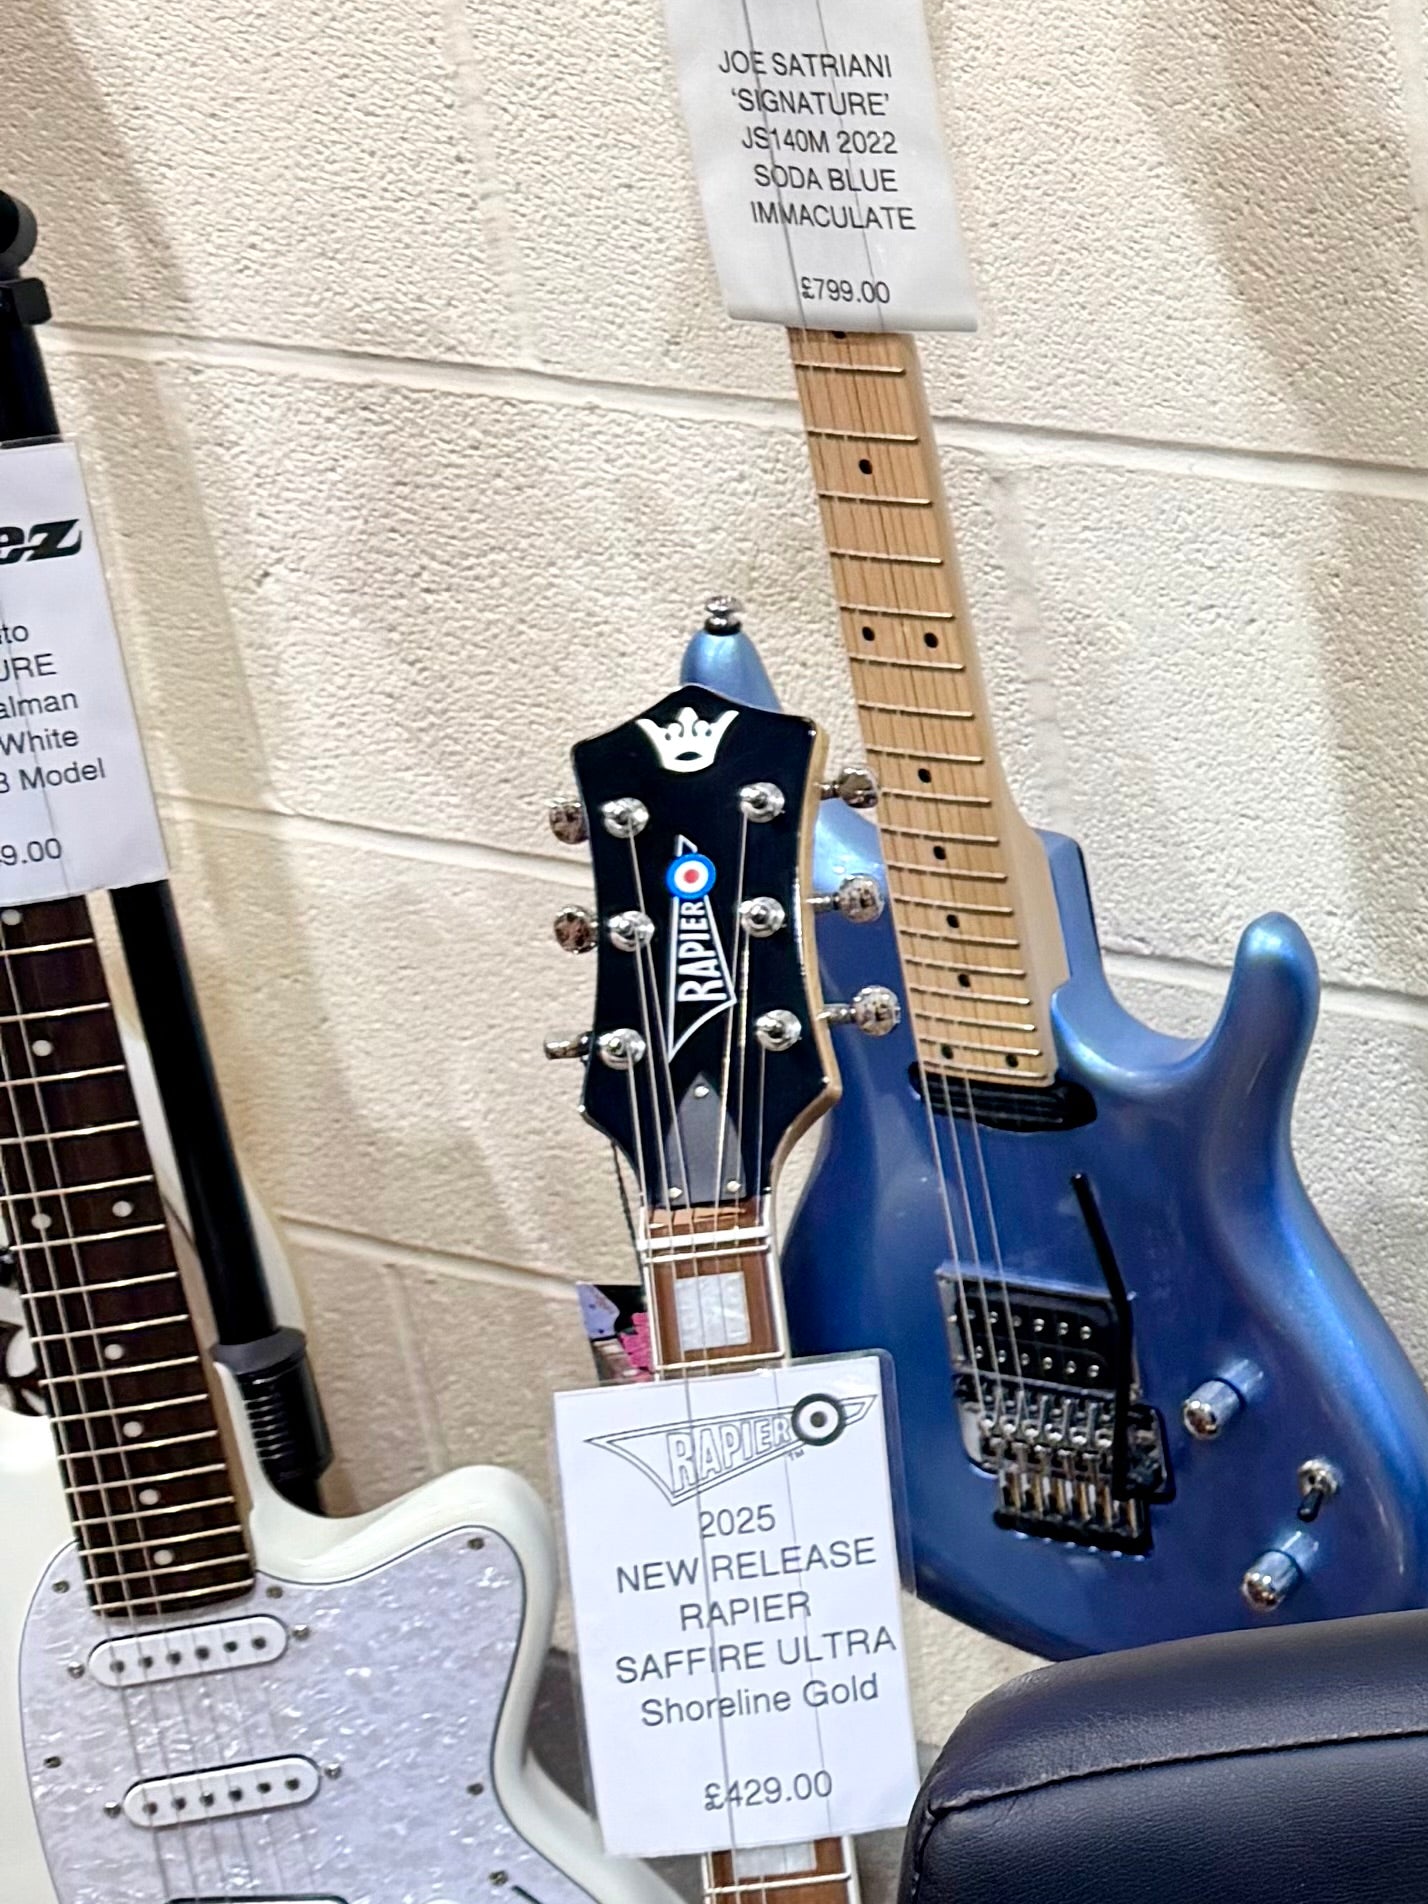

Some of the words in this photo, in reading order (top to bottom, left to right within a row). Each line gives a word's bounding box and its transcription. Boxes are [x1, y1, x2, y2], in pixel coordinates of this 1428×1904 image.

[718, 50, 765, 76] JOE
[772, 52, 892, 78] SATRIANI
[742, 126, 830, 154] JS140M
[837, 130, 898, 156] 2022
[754, 164, 823, 191] SODA
[829, 166, 898, 192] BLUE
[751, 201, 917, 231] IMMACULATE
[801, 277, 891, 304] £799.00
[0, 624, 29, 645] to
[19, 757, 106, 791] Model
[0, 838, 63, 867] 9.00
[678, 901, 728, 1002] RAPIER
[665, 1415, 792, 1494] RAPIER
[700, 1504, 776, 1539] 2025
[616, 1557, 699, 1594] NEW
[711, 1536, 877, 1583] RELEASE
[680, 1590, 812, 1632] RAPIER
[615, 1640, 766, 1685] SAFFIRE
[777, 1626, 898, 1665] ULTRA
[641, 1688, 791, 1728] Shoreline
[802, 1672, 880, 1708] Gold
[704, 1769, 833, 1813] £429.00
